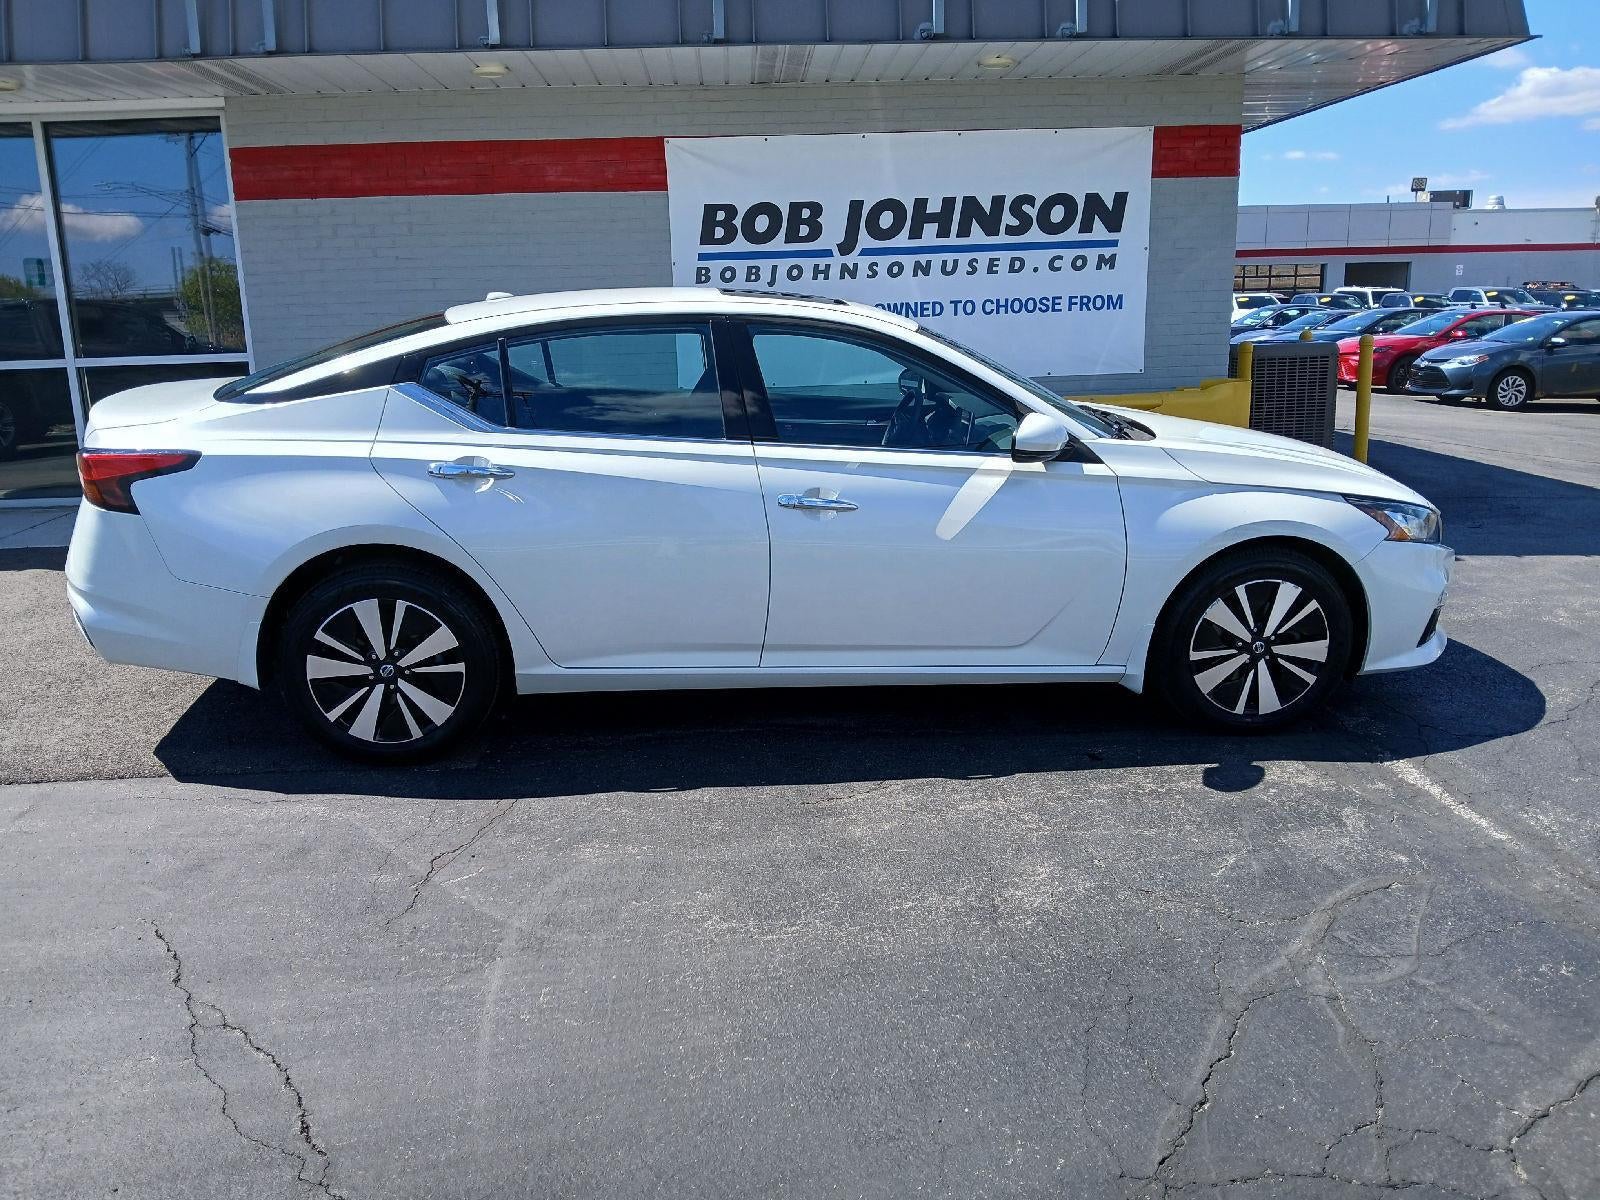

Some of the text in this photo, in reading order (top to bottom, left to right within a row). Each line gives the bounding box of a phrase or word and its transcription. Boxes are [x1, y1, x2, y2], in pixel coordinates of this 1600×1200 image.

[700, 191, 1129, 257] BOB JOHNSON
[695, 253, 1118, 288] BOBJOHNSONUSED.COM
[949, 299, 977, 317] TO
[981, 295, 1063, 315] CHOOSE
[1067, 293, 1124, 312] FROM
